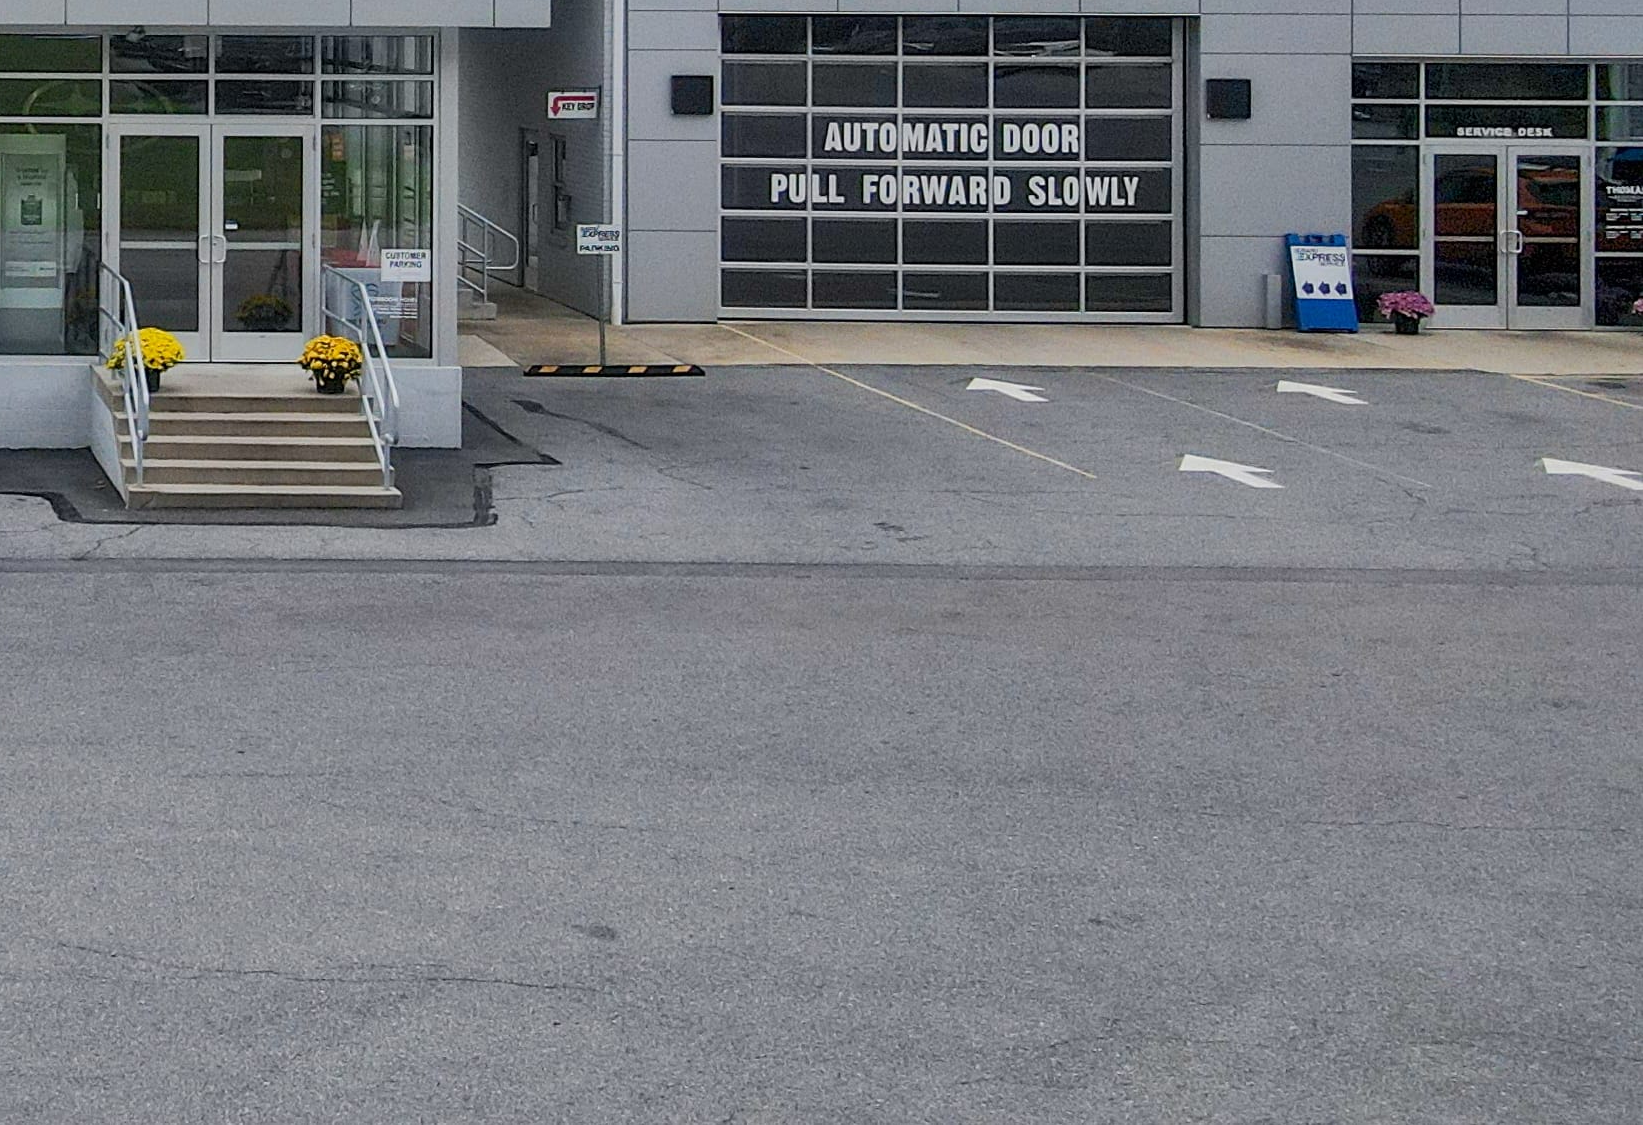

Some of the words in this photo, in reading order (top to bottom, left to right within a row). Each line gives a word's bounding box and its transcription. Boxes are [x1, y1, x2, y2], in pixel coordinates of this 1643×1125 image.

[1456, 126, 1512, 137] SERVICE
[1518, 127, 1553, 137] DESK
[824, 122, 988, 154] AUTOMATIC
[1003, 123, 1079, 154] DOOR
[770, 173, 845, 204] PULL
[862, 175, 1011, 205] FORWARD
[1027, 176, 1139, 207] SLOWLY
[385, 251, 426, 260] CUSTOMER
[389, 260, 422, 269] PARKING
